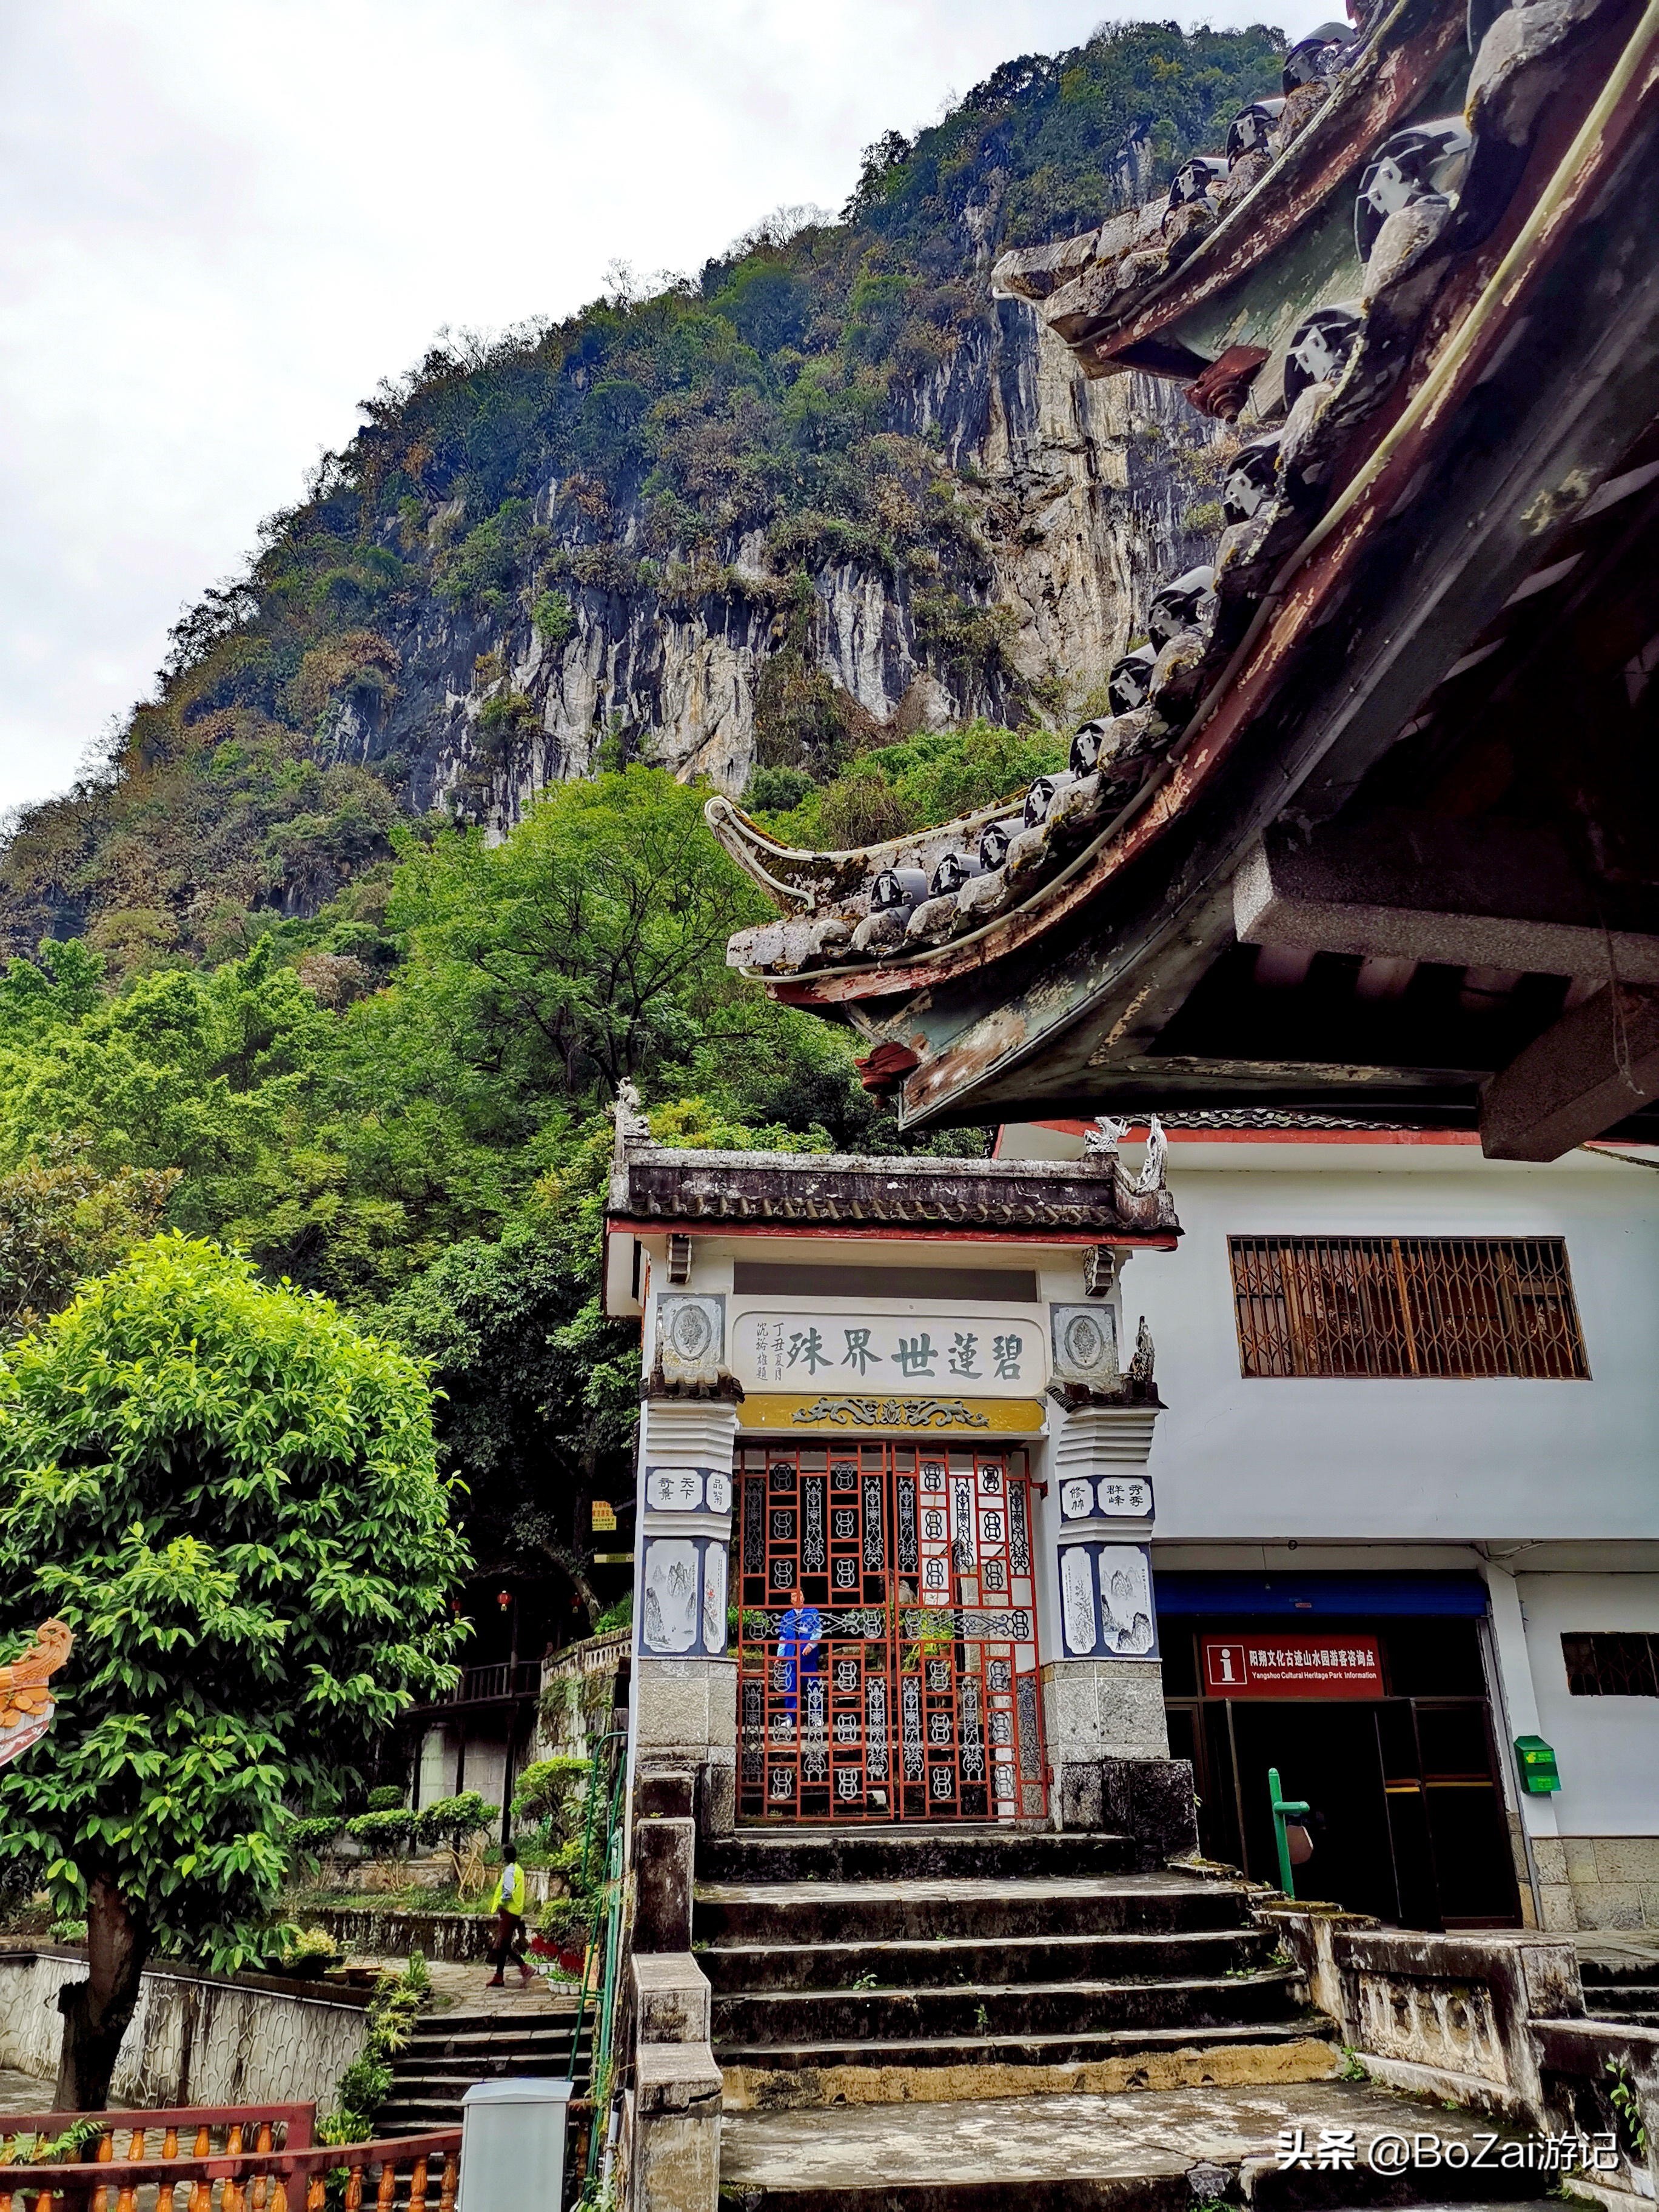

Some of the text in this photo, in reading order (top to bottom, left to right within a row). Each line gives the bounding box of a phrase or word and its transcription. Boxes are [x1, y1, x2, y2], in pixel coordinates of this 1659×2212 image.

[1248, 1649, 1375, 1667] 阳朔文化古迹山水园游客咨询点
[1252, 1671, 1281, 1680] Yangshuo
[1304, 1671, 1329, 1680] Heritage
